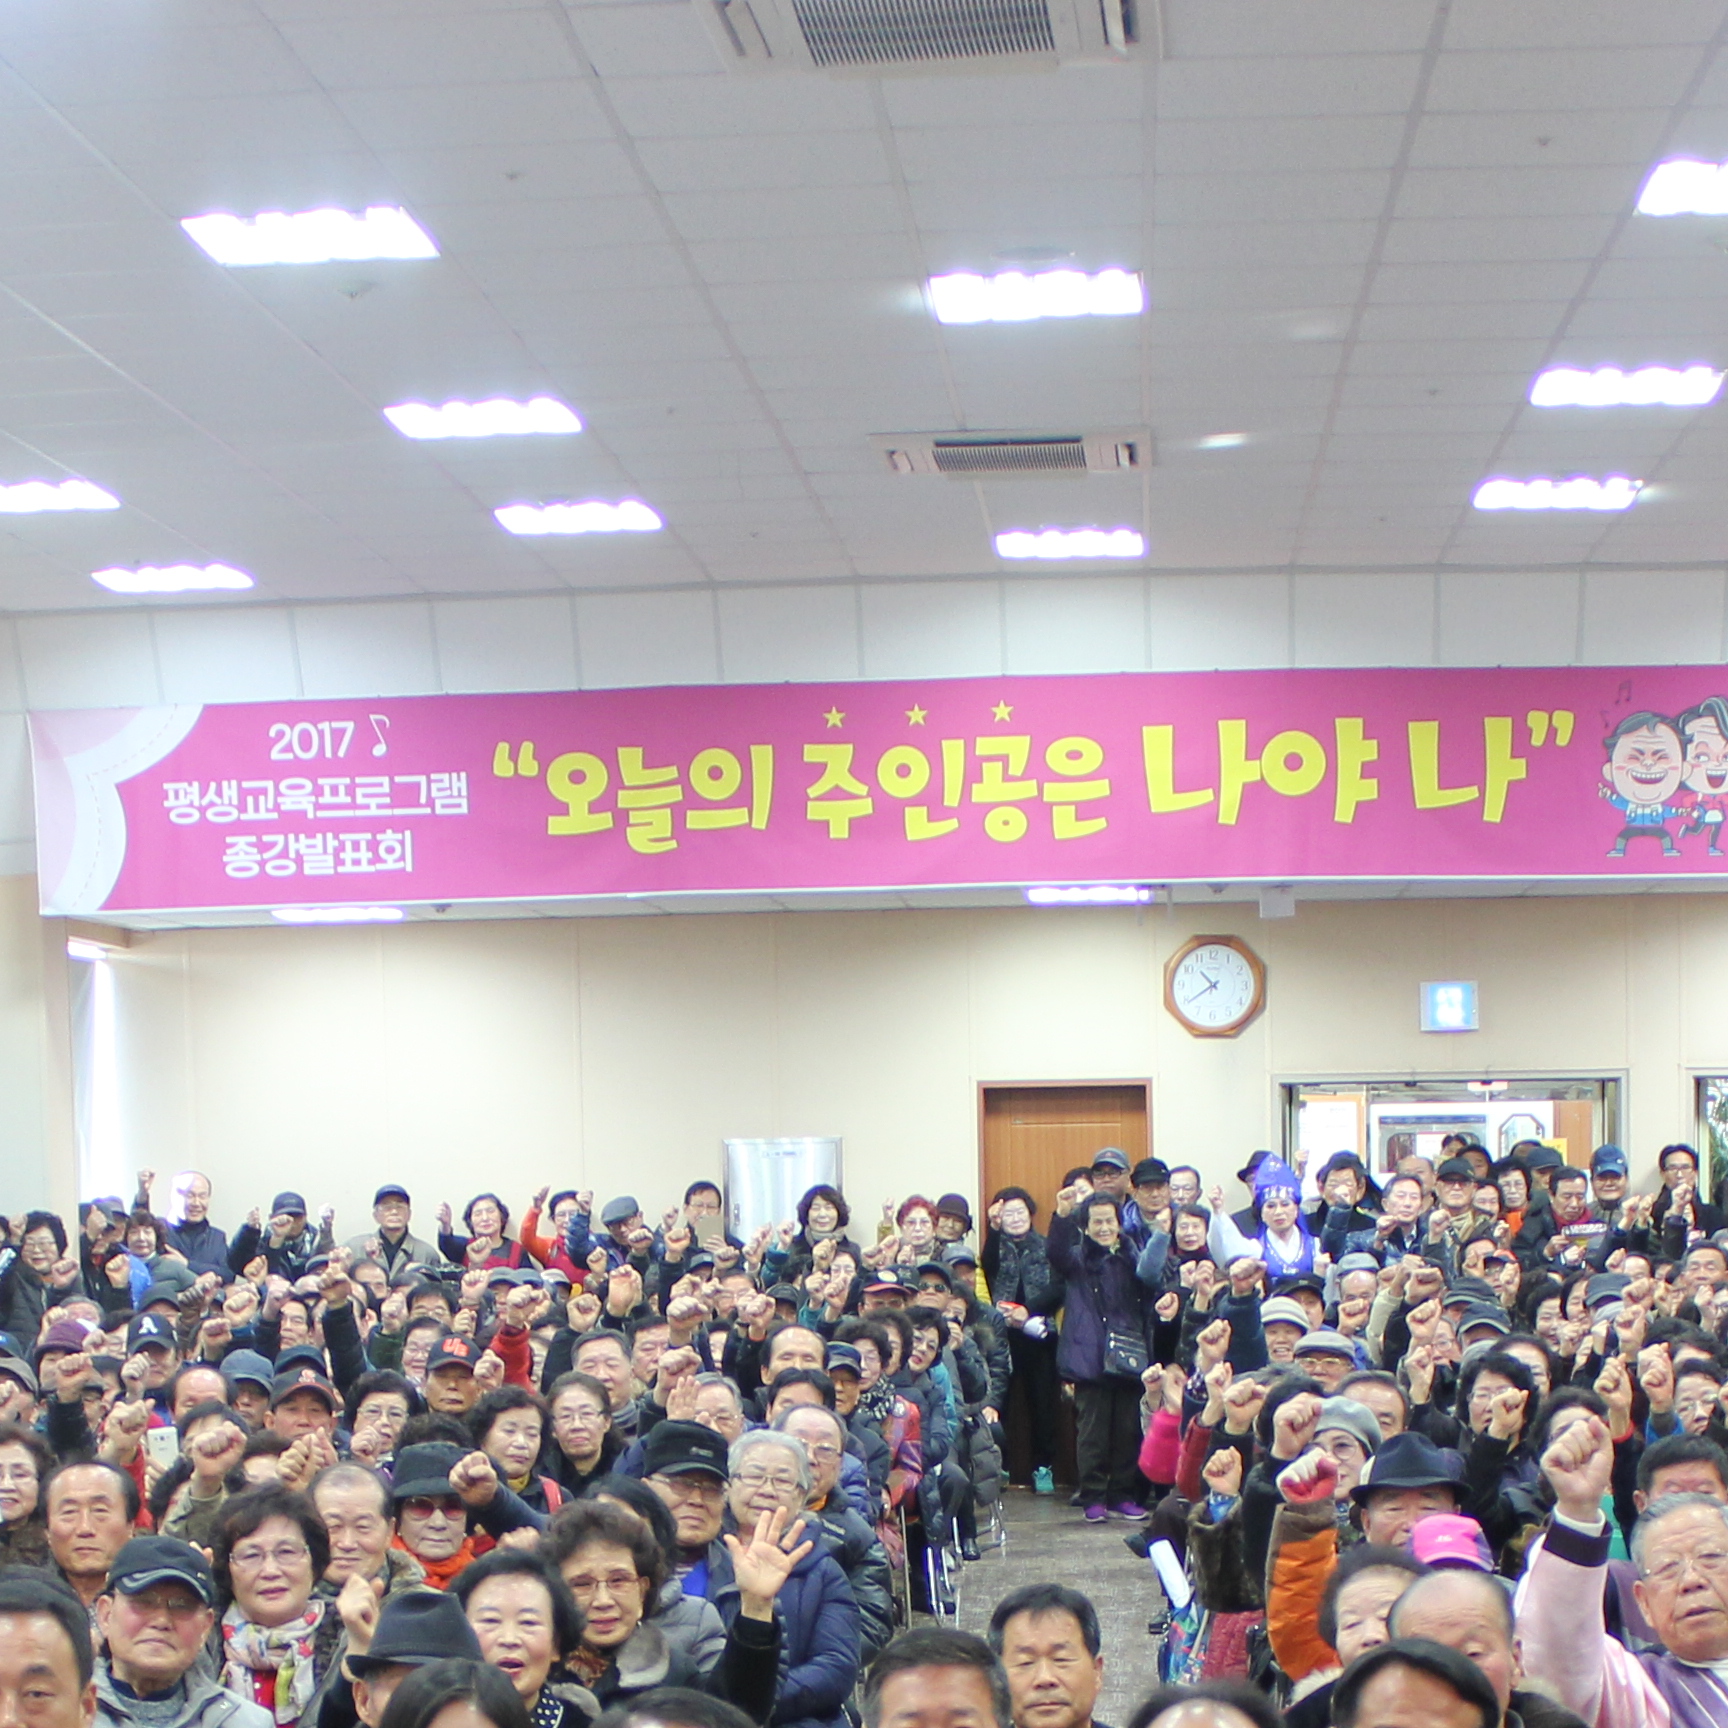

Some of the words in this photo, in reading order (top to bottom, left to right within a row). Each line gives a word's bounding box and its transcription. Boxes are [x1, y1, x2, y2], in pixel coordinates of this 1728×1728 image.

[268, 721, 356, 761] 2017
[162, 771, 470, 826] 평생교육프로그램
[802, 735, 1112, 844] 주인공은
[1141, 717, 1380, 826] 나야
[222, 828, 414, 879] 종강발표회
